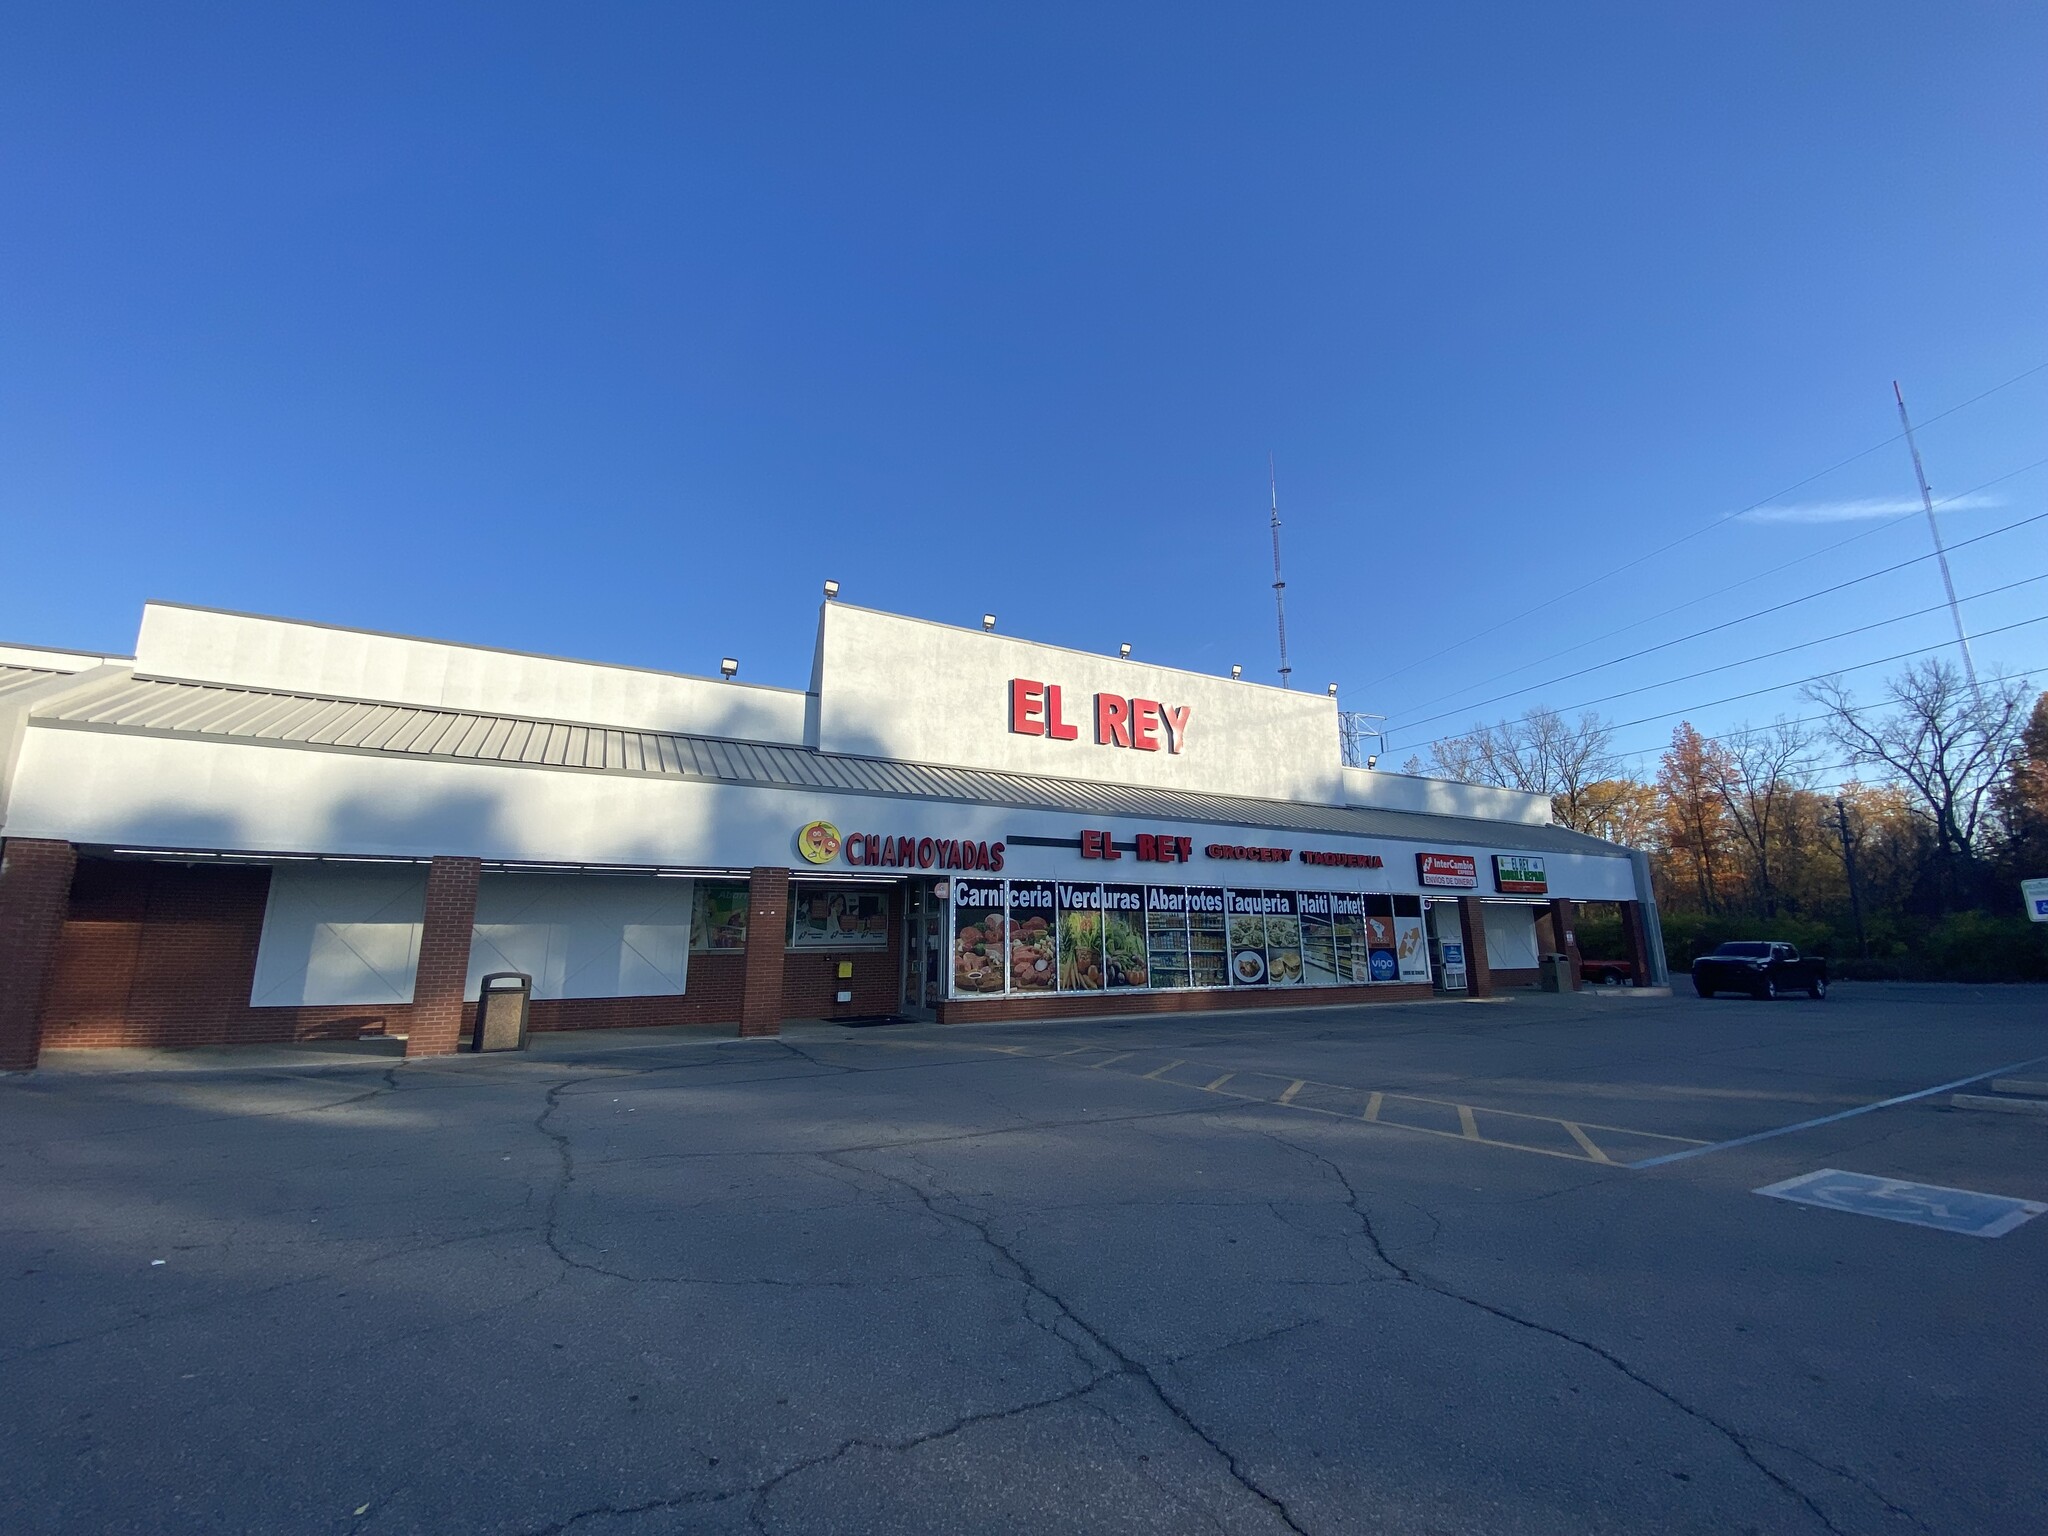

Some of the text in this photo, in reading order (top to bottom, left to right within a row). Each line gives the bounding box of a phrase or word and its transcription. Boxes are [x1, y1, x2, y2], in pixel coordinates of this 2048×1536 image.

[1008, 678, 1192, 755] EL REY
[846, 832, 1006, 872] CHAMOYADAS
[1080, 829, 1193, 863] EL REY
[1205, 844, 1384, 869] GROCERY TAQUERIA
[1433, 858, 1474, 871] InterCambio
[956, 882, 1053, 907] Carniceria
[1059, 885, 1141, 909] Verduras
[1149, 888, 1223, 911] Abarrotes
[1225, 891, 1290, 915] Taqueria
[1300, 894, 1362, 915] Haiti Market
[1371, 958, 1393, 970] vigo
